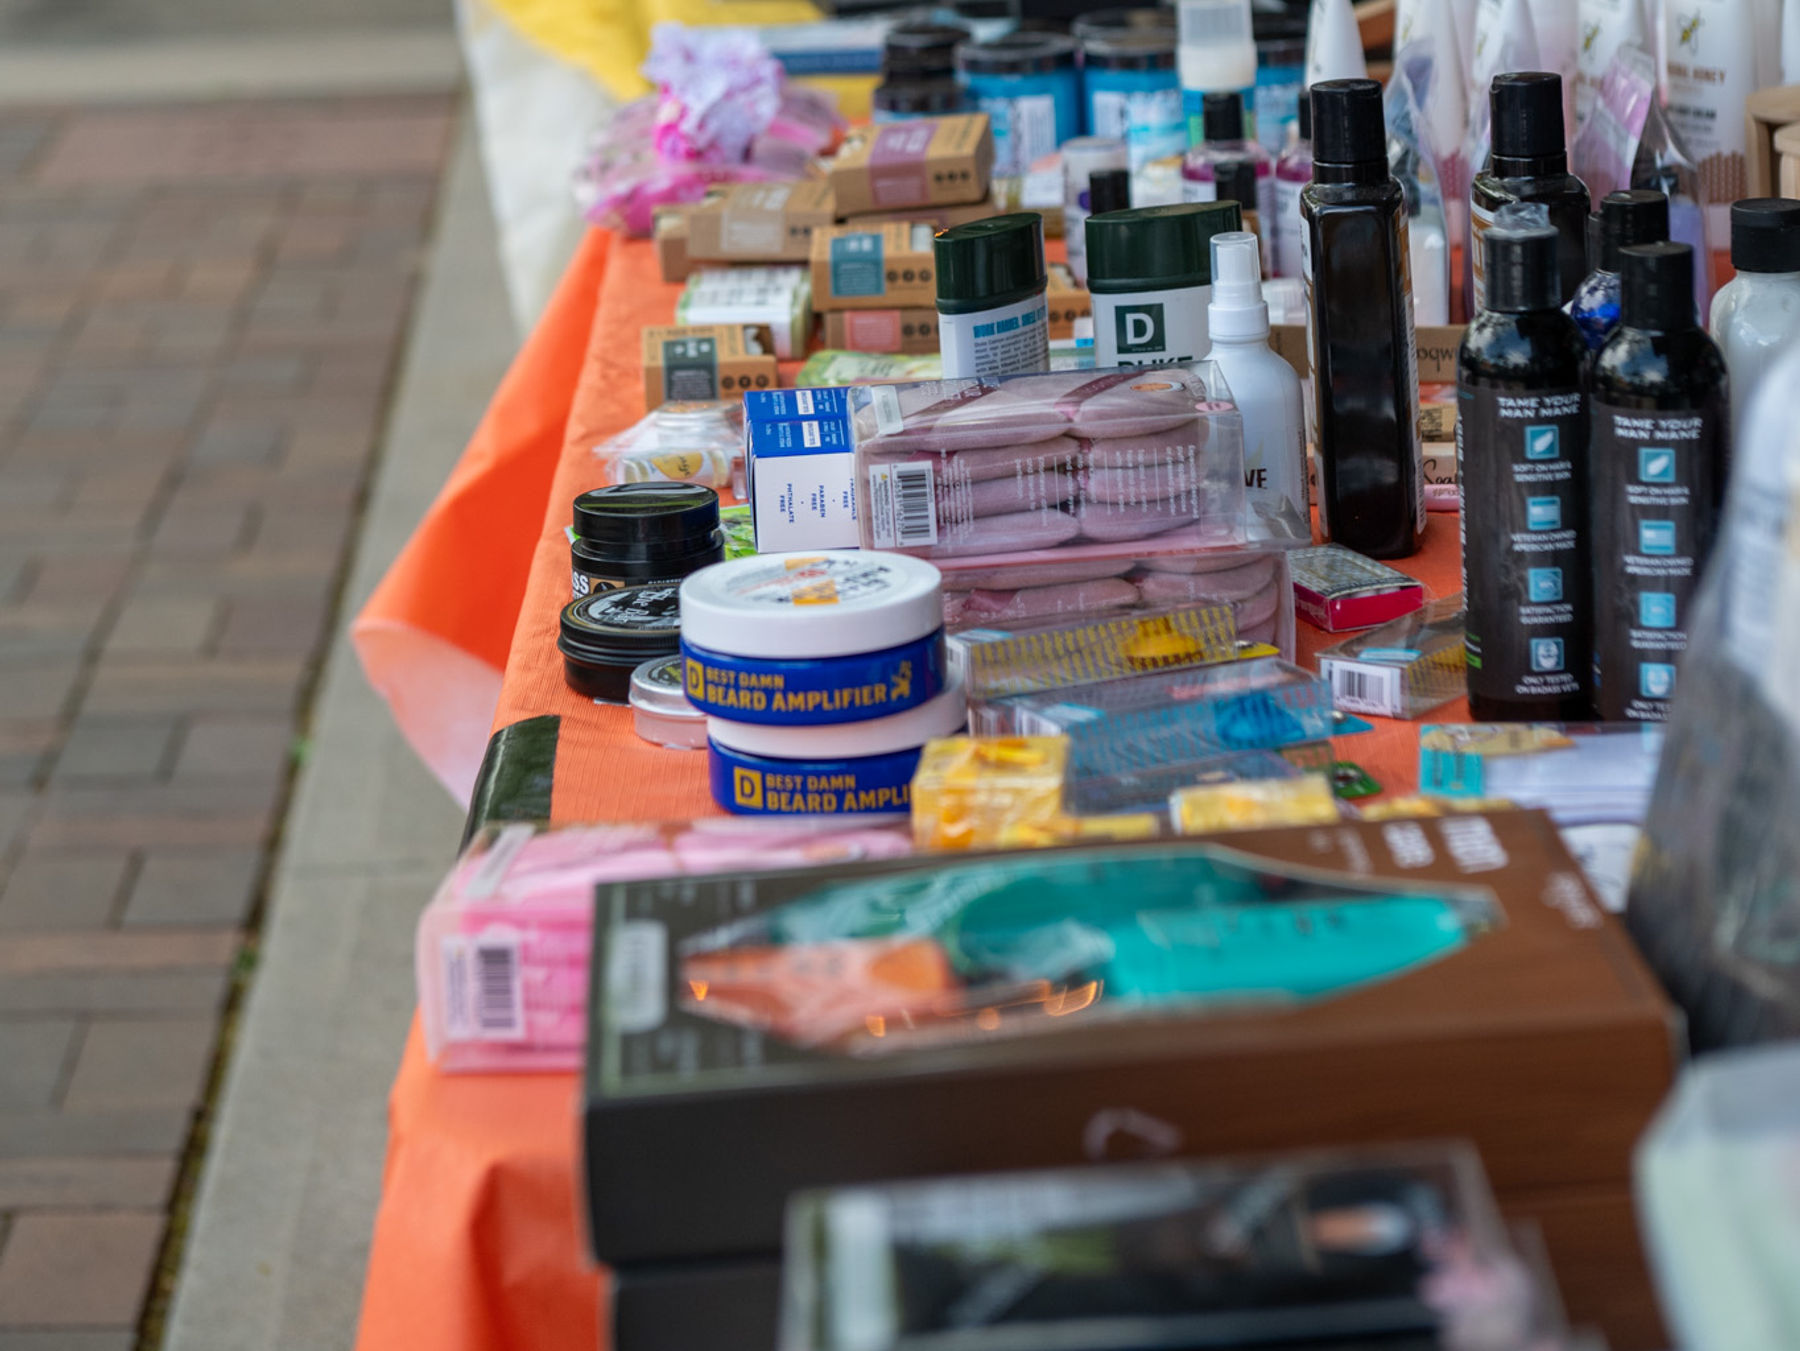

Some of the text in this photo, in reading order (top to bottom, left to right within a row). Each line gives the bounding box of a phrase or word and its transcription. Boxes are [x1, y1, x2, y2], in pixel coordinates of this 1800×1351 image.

[1125, 312, 1155, 345] D
[1497, 392, 1581, 408] TAME YOUR
[1499, 405, 1580, 418] MAN MANE
[1612, 415, 1703, 429] TAME YOUR
[1614, 427, 1650, 439] MAN
[706, 666, 784, 688] BEST DAMN
[707, 683, 887, 712] BEARD AMPLIFIER
[739, 774, 755, 798] D
[765, 773, 856, 792] BEST DAMN
[766, 791, 837, 813] BEARD
